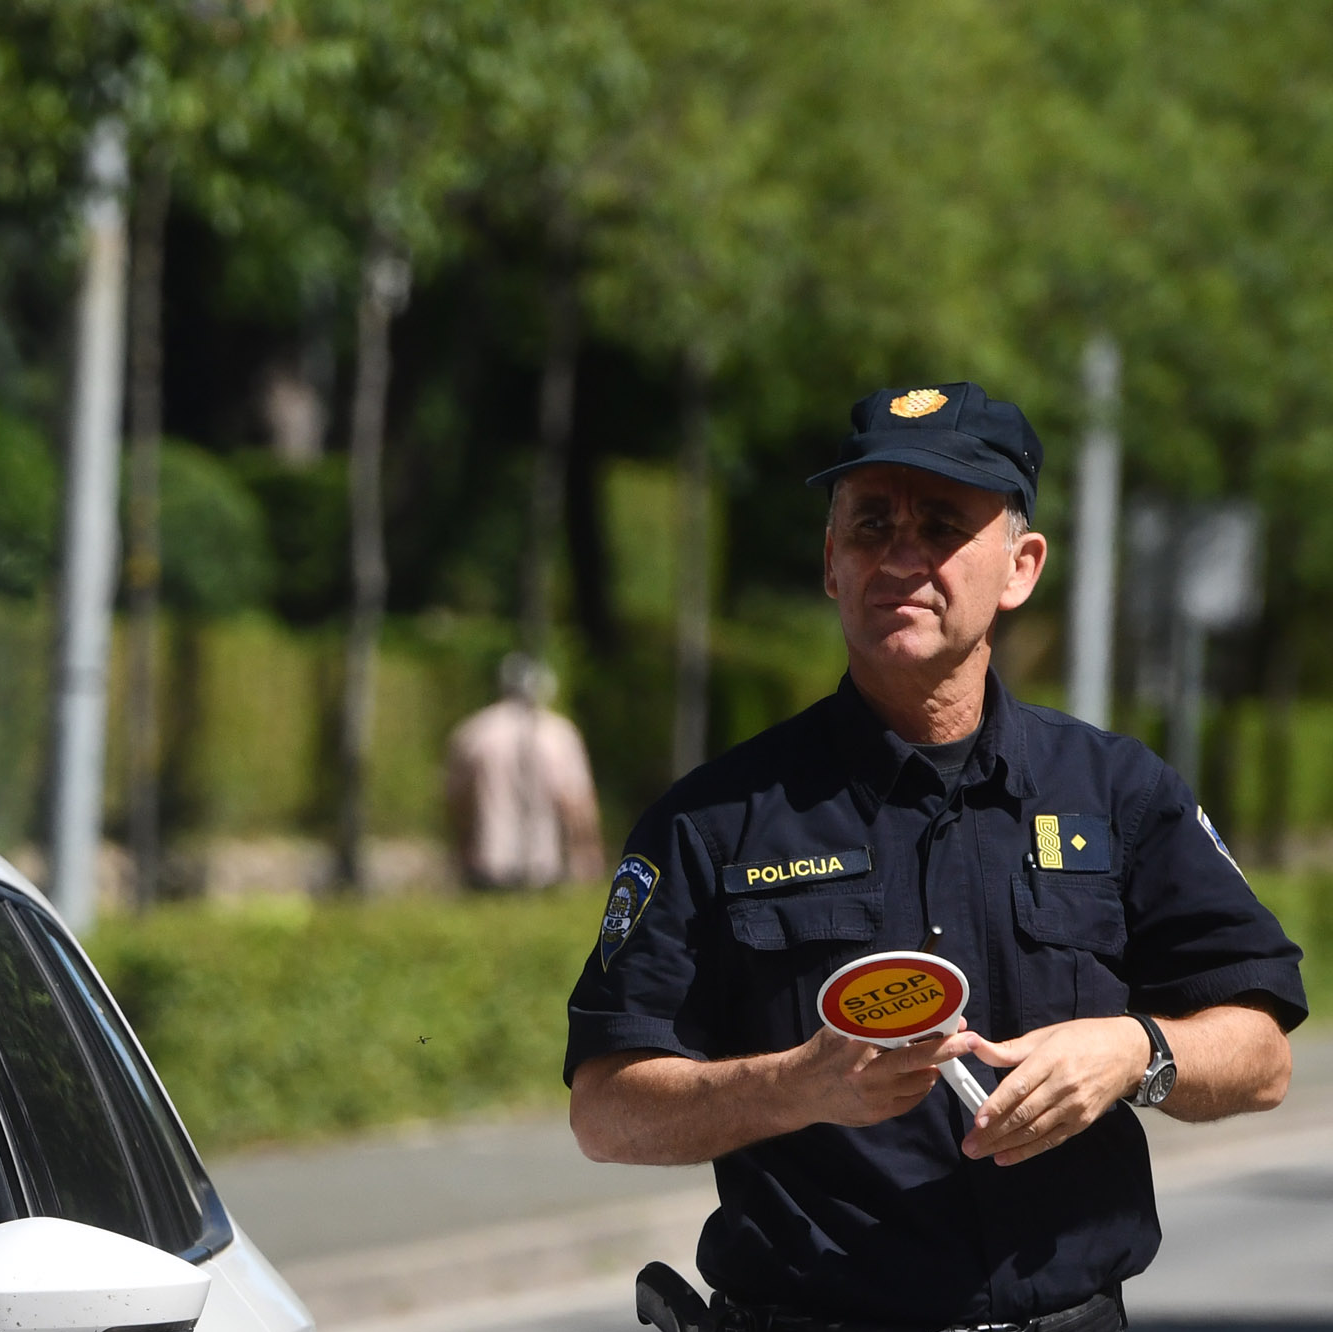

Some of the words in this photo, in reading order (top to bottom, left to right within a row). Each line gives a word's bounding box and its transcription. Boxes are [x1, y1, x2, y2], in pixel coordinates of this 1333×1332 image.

[746, 856, 845, 885] POLICIJA
[843, 973, 928, 1011] STOP
[853, 987, 945, 1025] POLICIJA
